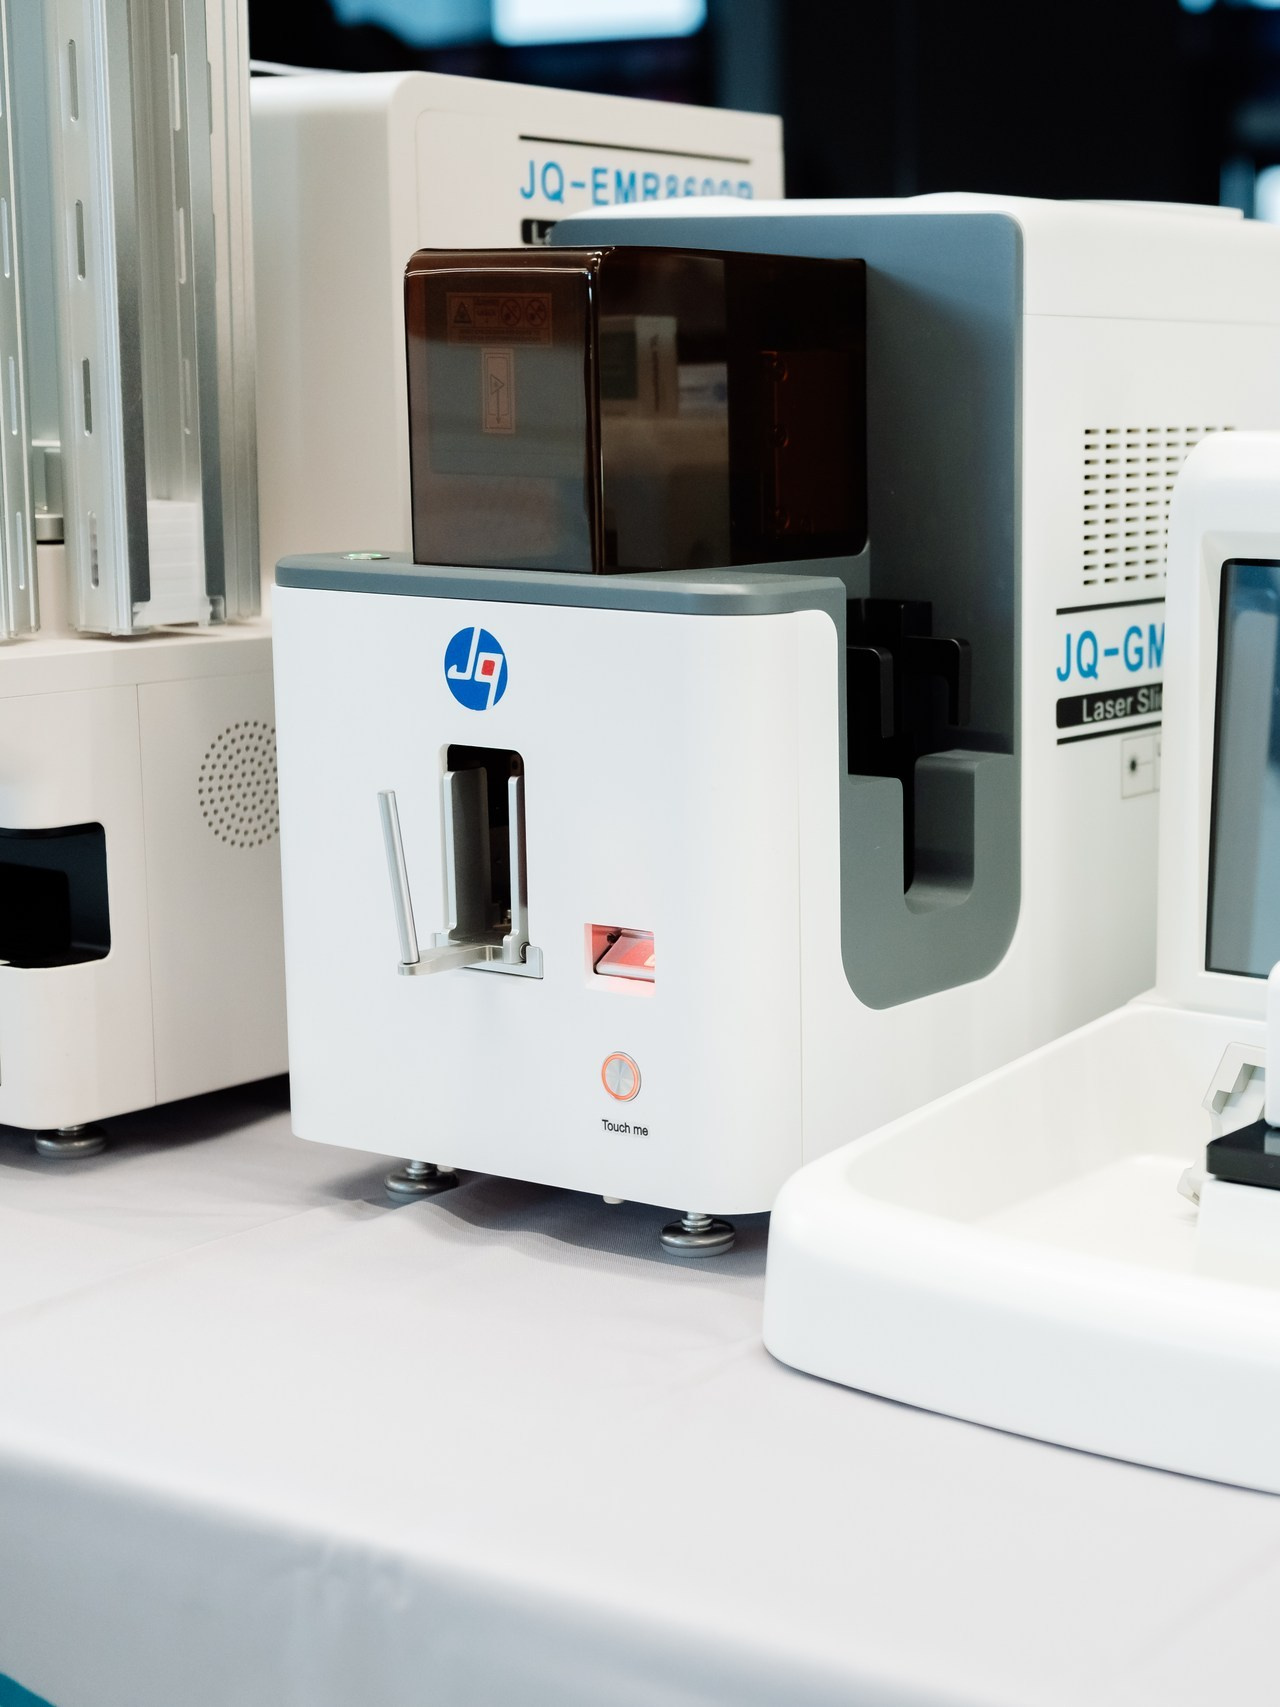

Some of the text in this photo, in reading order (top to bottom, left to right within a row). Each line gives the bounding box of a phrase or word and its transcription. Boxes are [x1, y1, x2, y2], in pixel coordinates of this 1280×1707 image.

[1082, 687, 1162, 722] Laser Sli
[602, 1119, 649, 1136] Touch me
